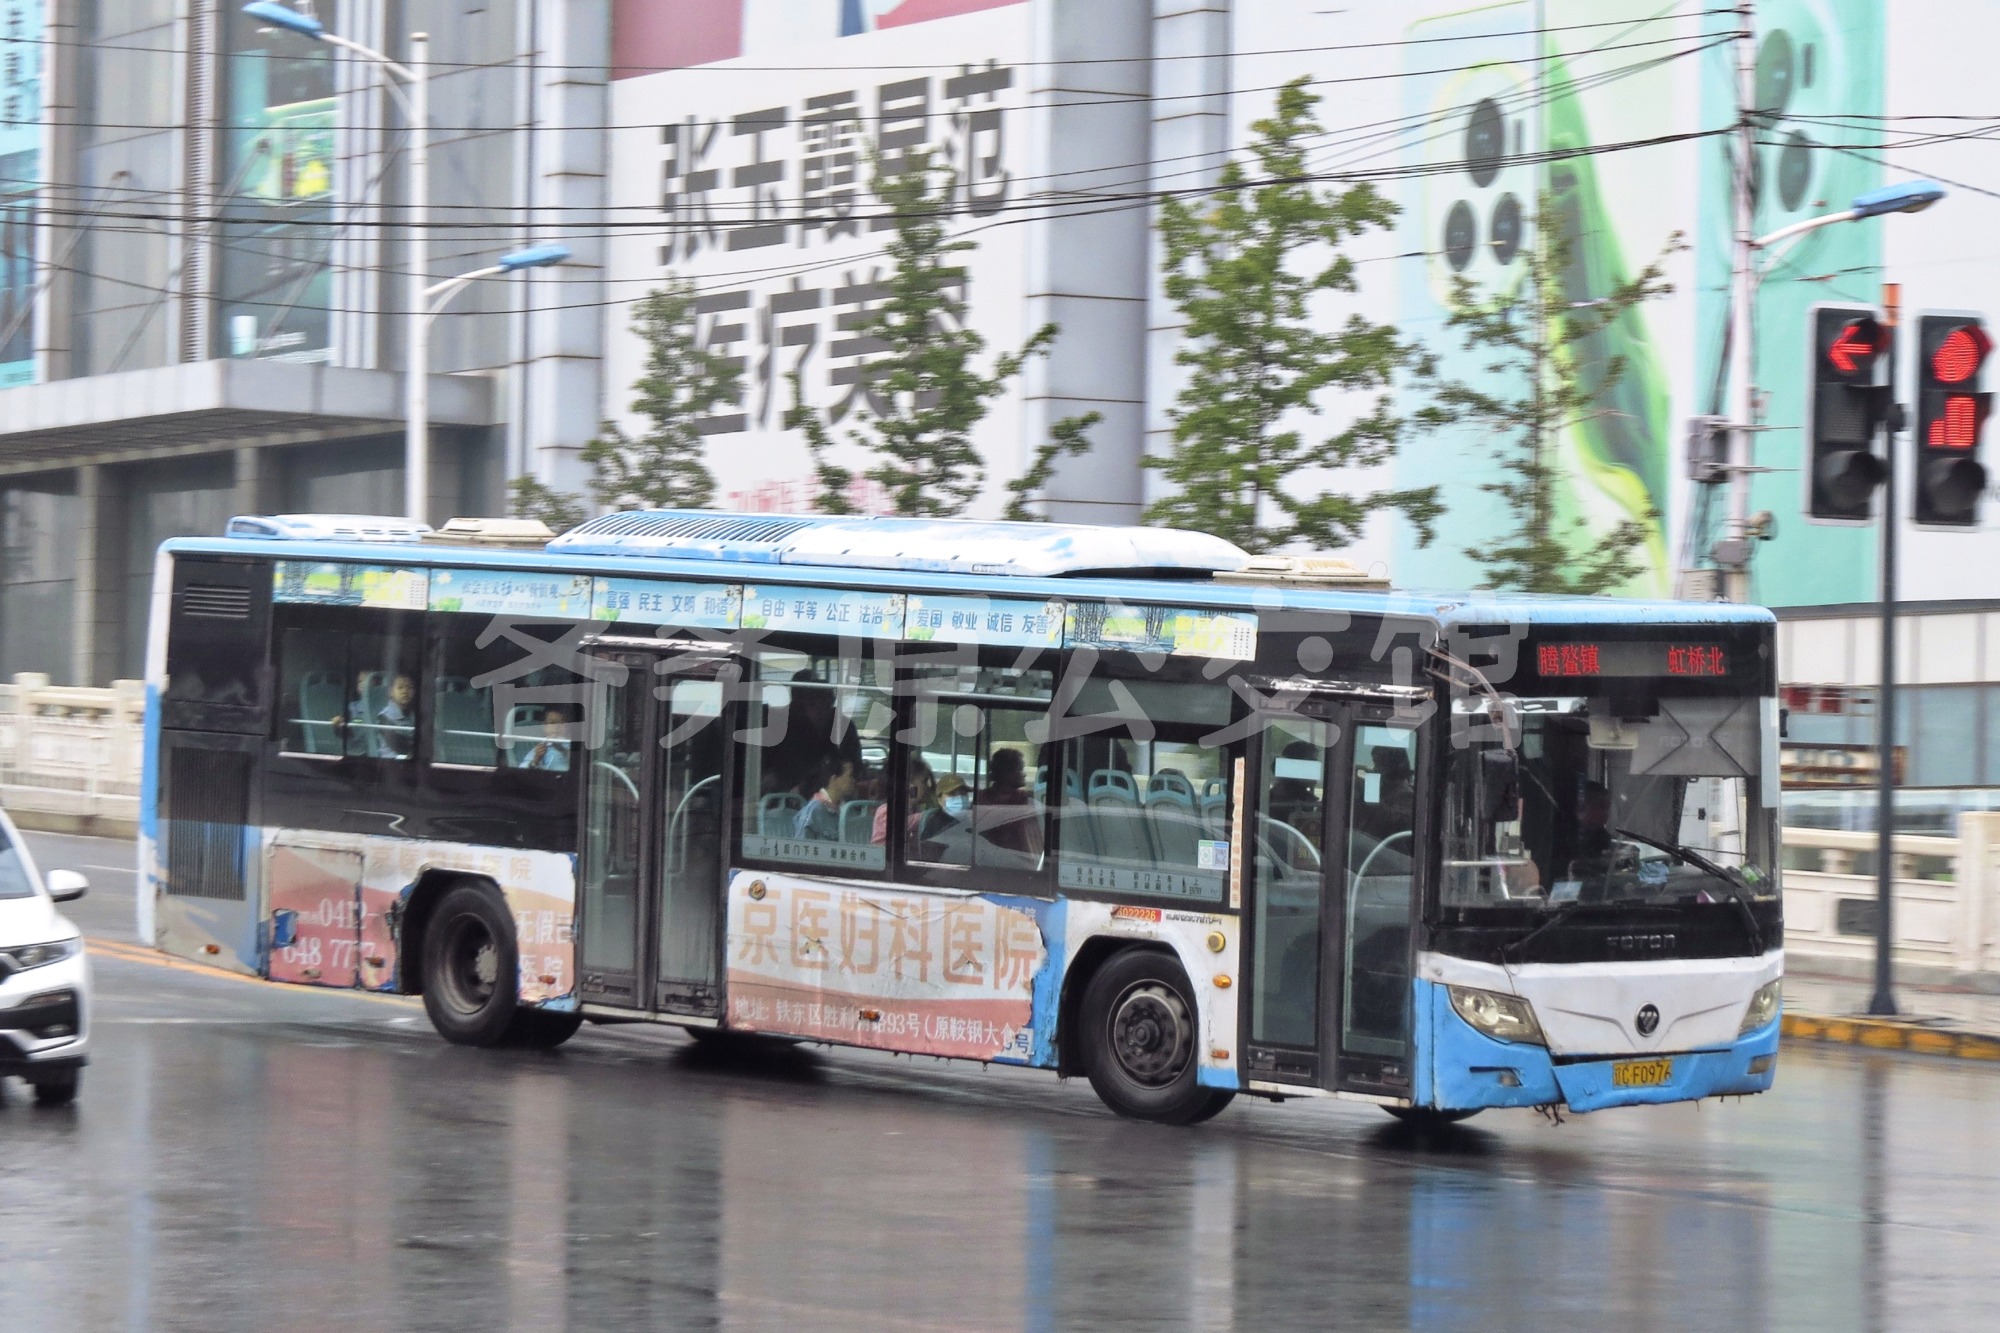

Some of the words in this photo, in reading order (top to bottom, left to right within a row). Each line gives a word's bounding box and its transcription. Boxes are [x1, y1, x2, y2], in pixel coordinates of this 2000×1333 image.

[606, 590, 630, 610] 富强
[638, 593, 663, 612] 民主
[671, 594, 695, 613] 文明
[703, 597, 729, 616] 和谐
[761, 598, 785, 617] 自由
[793, 600, 818, 620] 平等
[826, 602, 851, 622] 公正
[859, 604, 884, 624] 法治
[916, 608, 942, 628] 爱国
[952, 611, 977, 630] 敬业
[986, 612, 1013, 632] 诚信
[1021, 614, 1049, 634] 友善
[1668, 645, 1726, 676] 虹桥北
[738, 887, 1040, 992] 京医妇科医院
